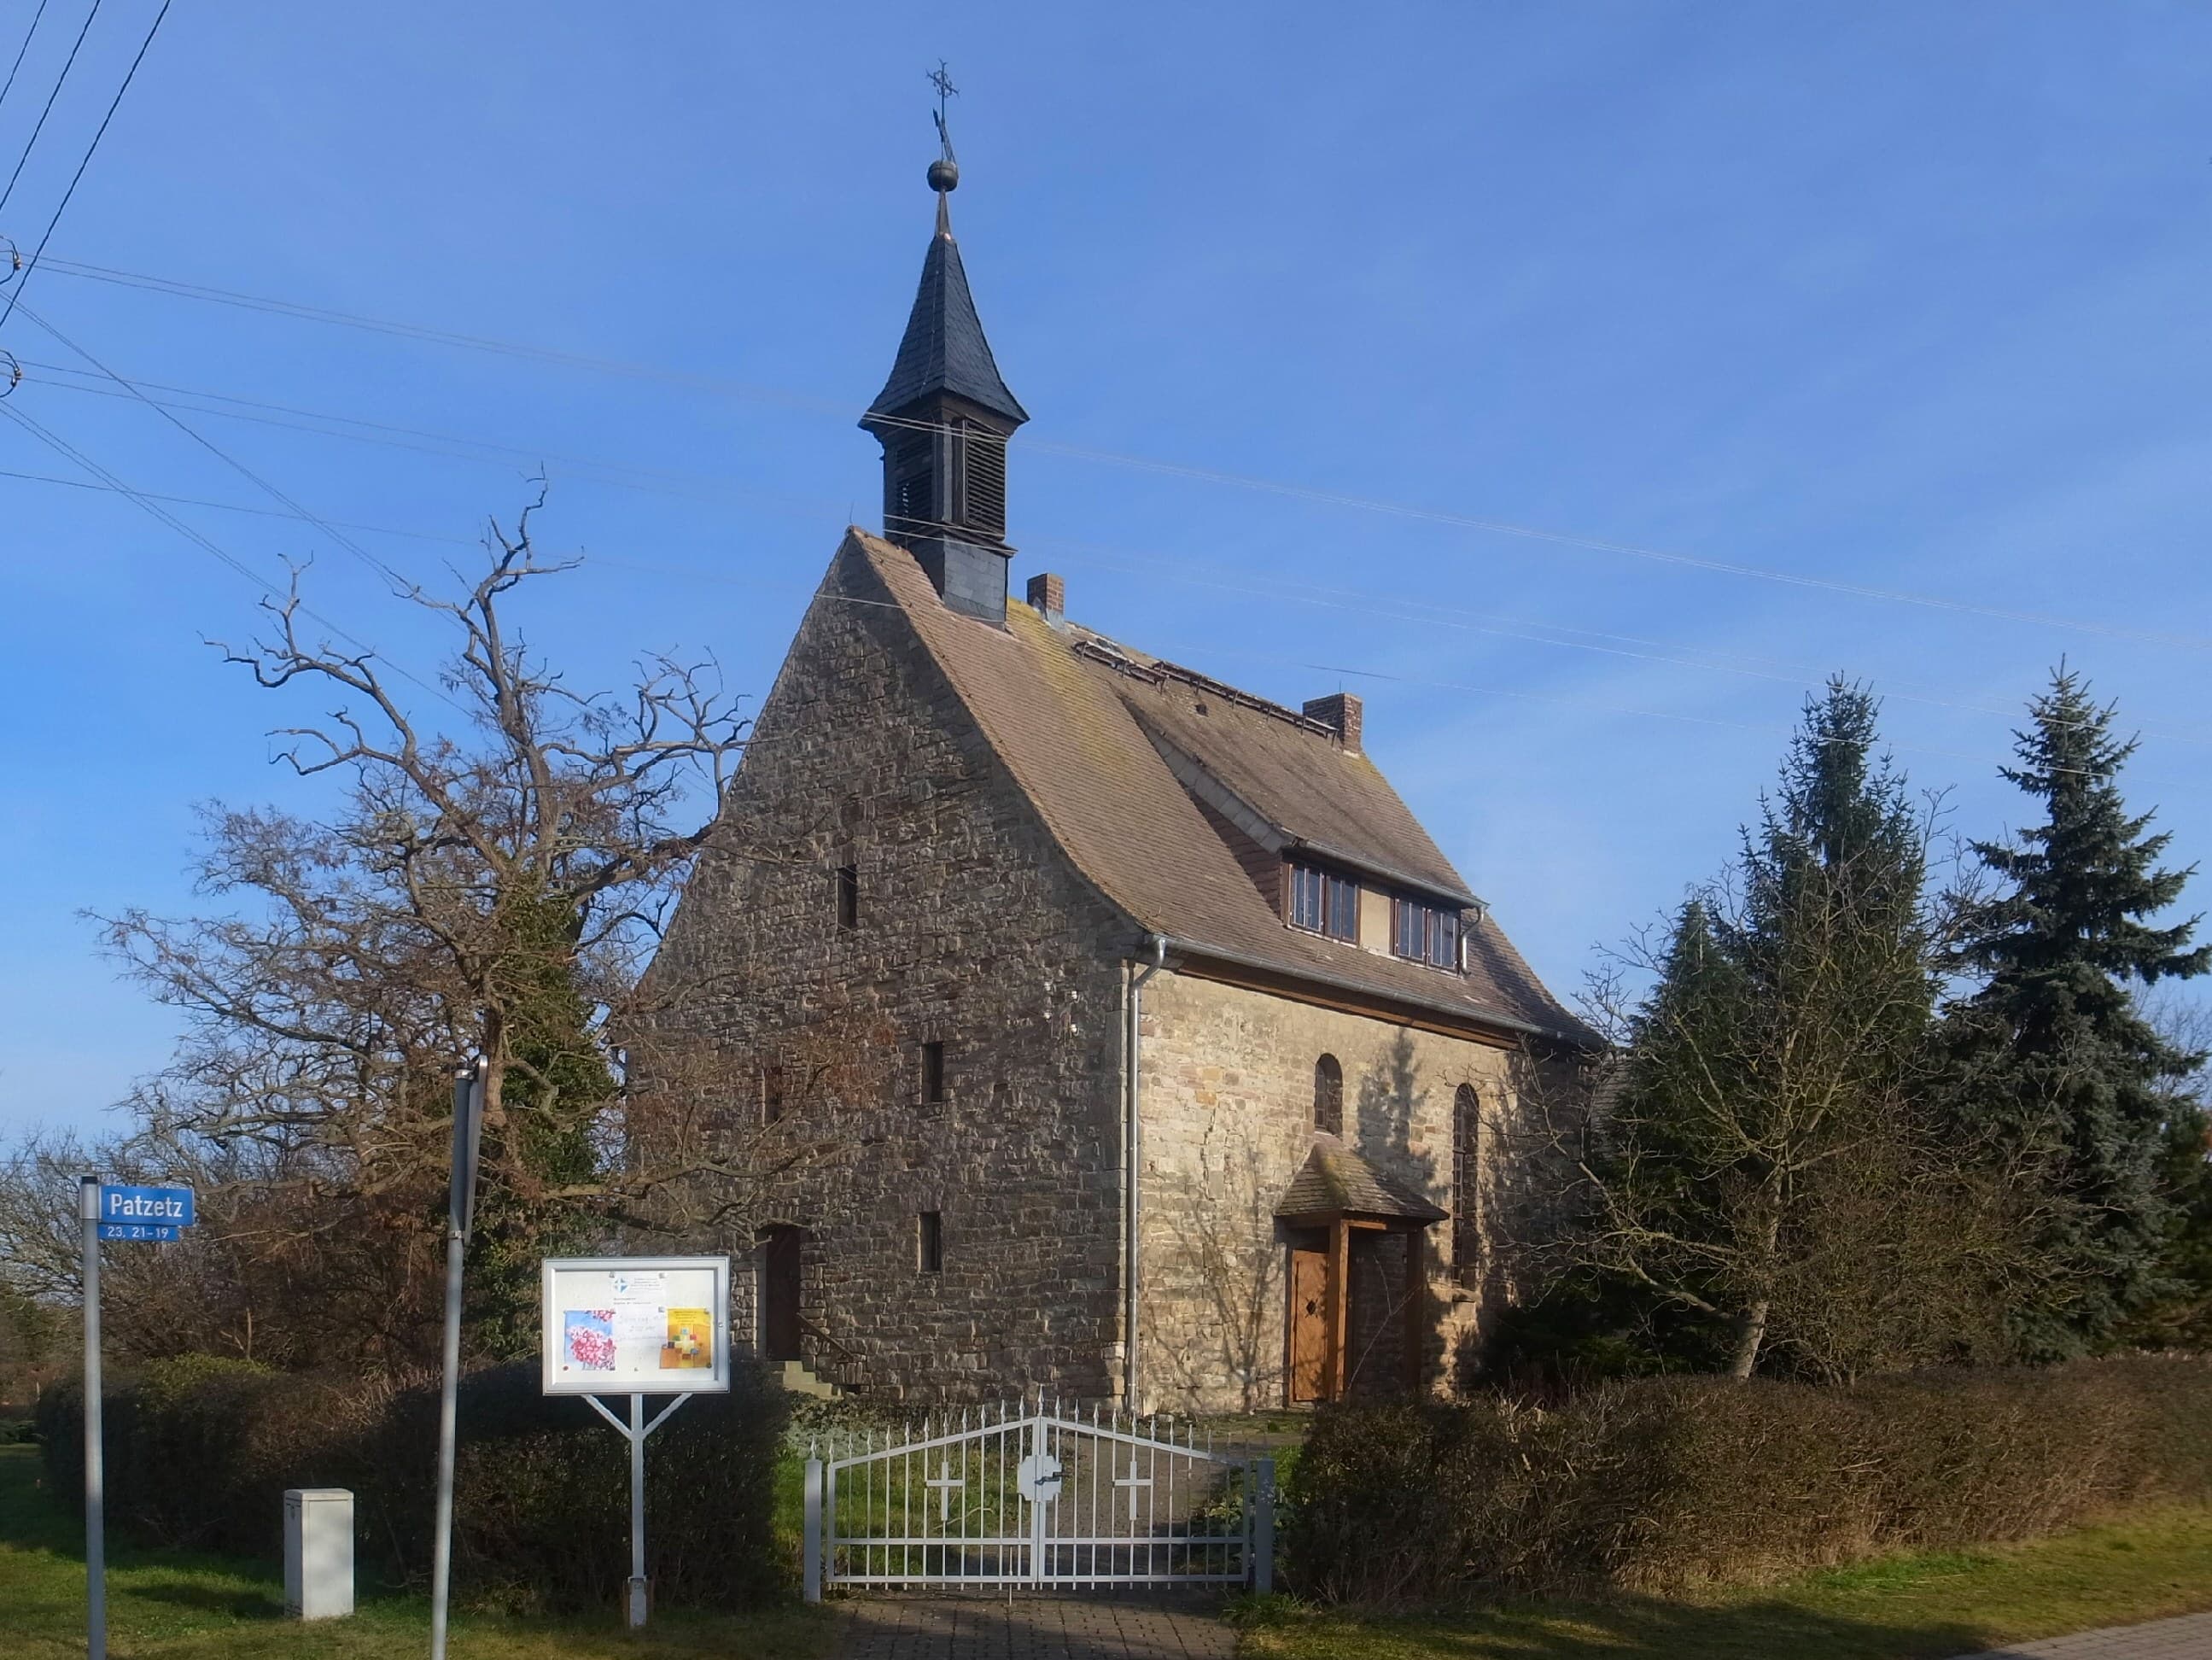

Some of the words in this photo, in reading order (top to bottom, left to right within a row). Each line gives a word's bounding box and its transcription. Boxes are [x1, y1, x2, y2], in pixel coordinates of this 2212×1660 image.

[110, 1193, 184, 1218] Patzetz
[108, 1226, 126, 1238] 23,
[131, 1226, 169, 1238] 21-19
